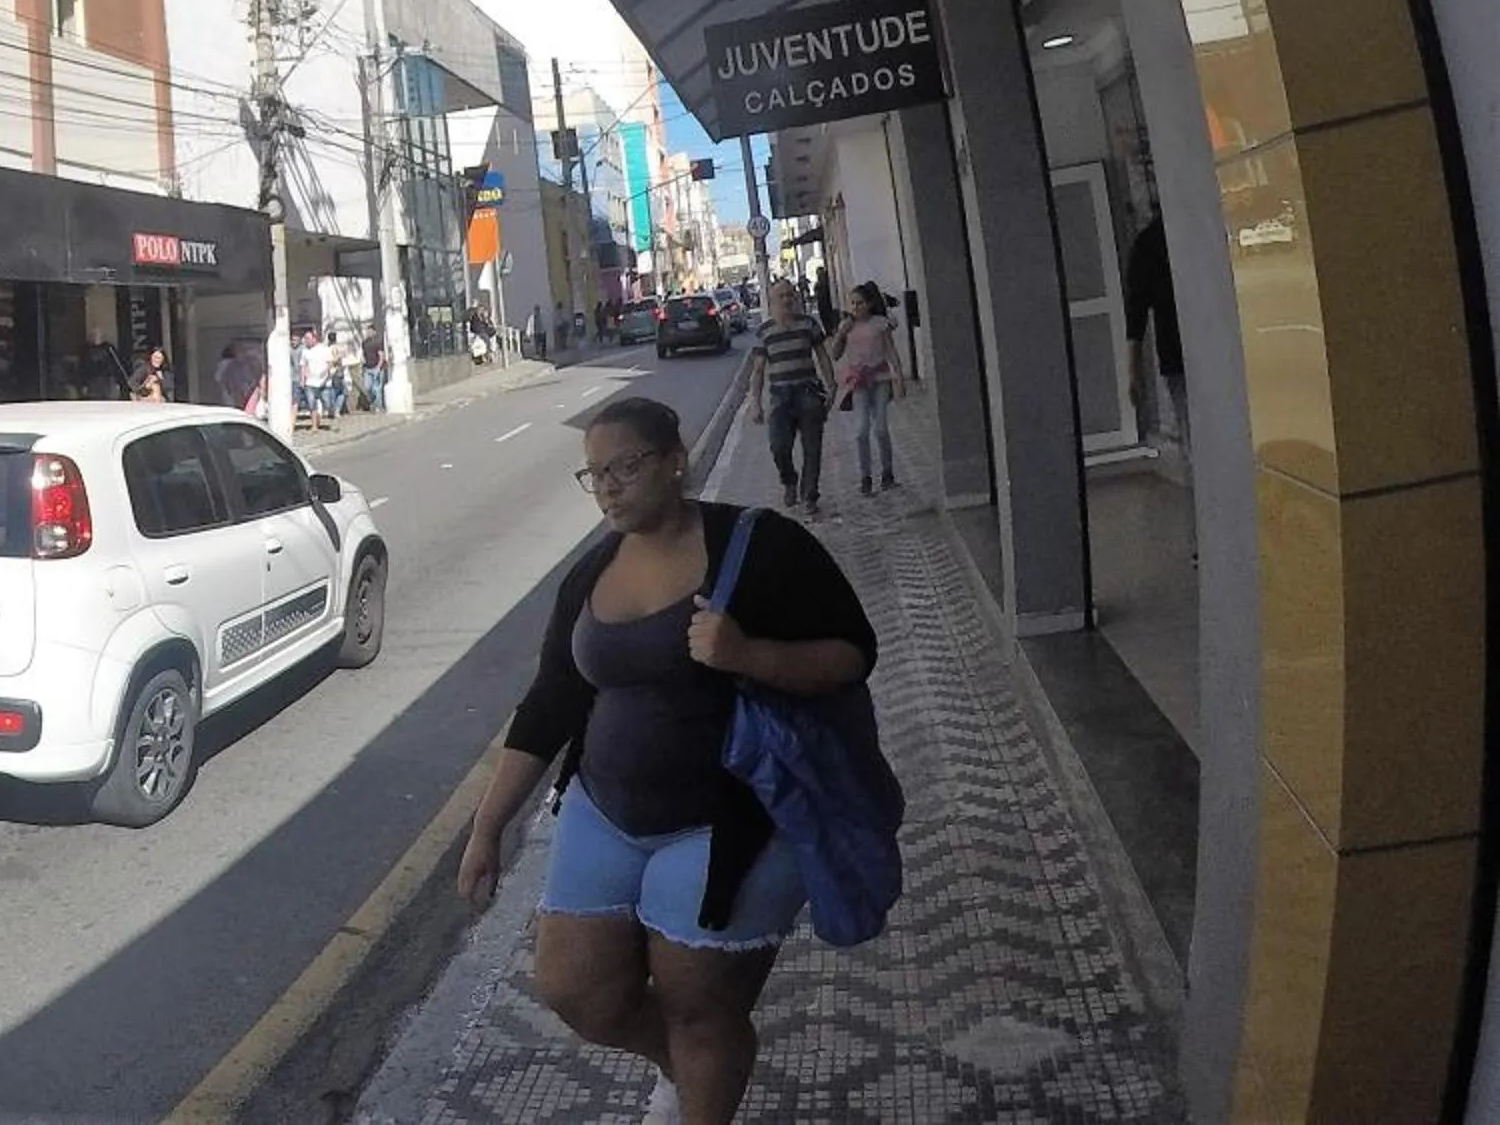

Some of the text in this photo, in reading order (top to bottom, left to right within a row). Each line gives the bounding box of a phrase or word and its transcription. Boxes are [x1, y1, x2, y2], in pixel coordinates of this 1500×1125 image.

[717, 10, 931, 80] JUVENTUDE
[744, 63, 916, 114] CALÇADOS
[135, 234, 217, 265] POLO NTPK
